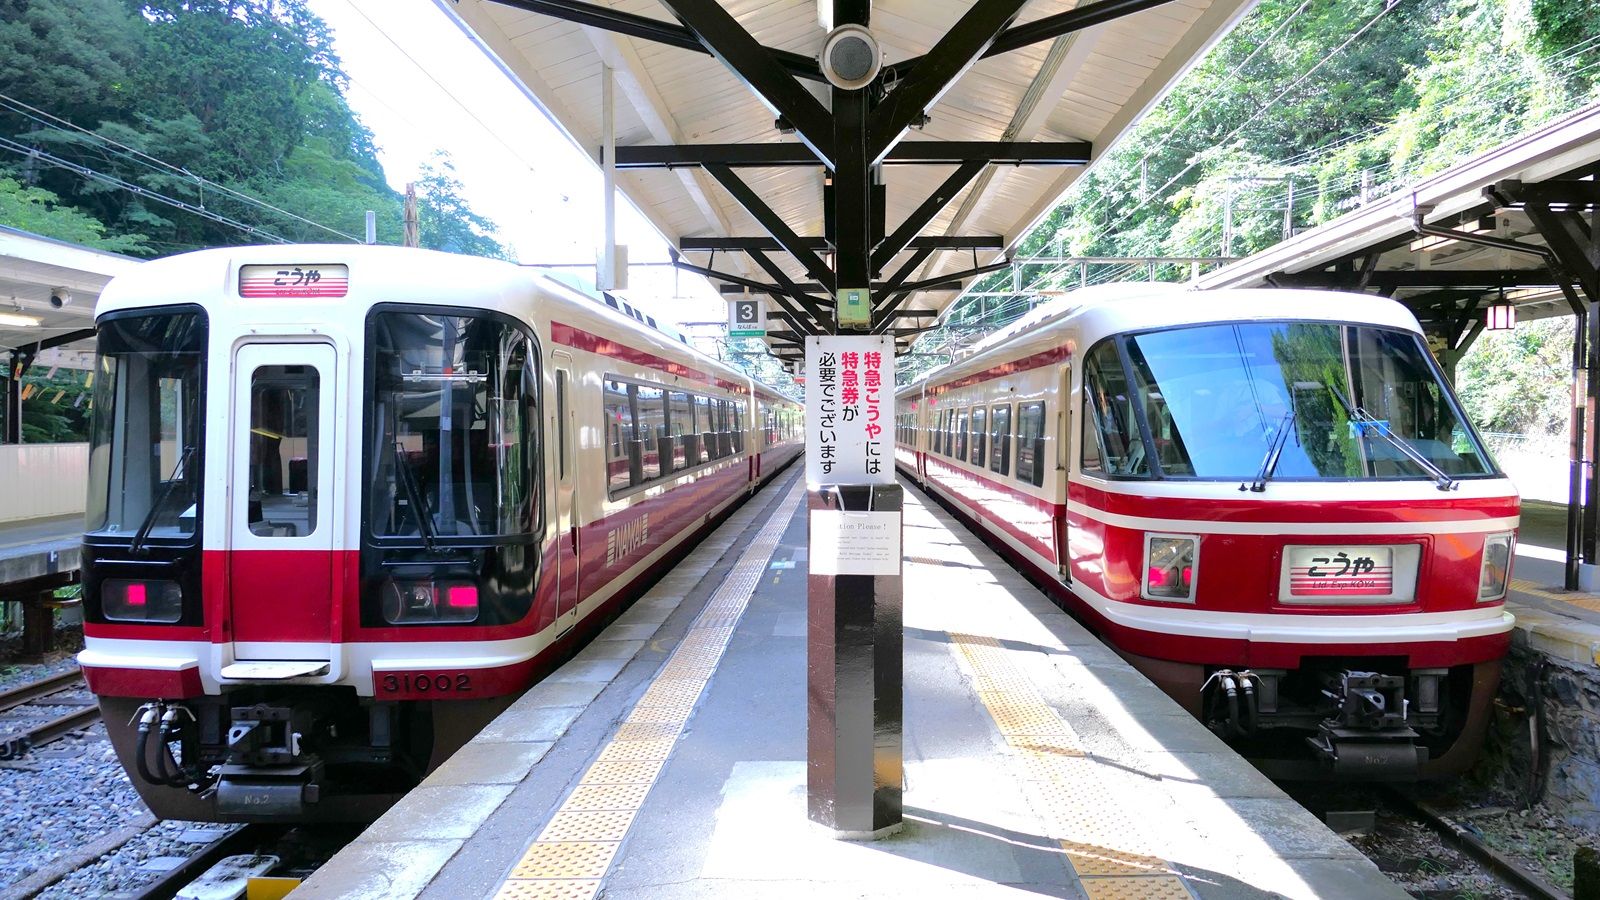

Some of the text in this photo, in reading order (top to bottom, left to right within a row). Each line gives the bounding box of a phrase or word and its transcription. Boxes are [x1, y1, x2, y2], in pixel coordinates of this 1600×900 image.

[274, 267, 321, 286] こうや
[741, 304, 753, 320] 3
[841, 351, 859, 422] 特急券が
[819, 351, 836, 475] 必要でございます
[864, 351, 881, 475] 特急こうやには
[1308, 552, 1375, 577] こうや
[383, 674, 472, 692] 31002
